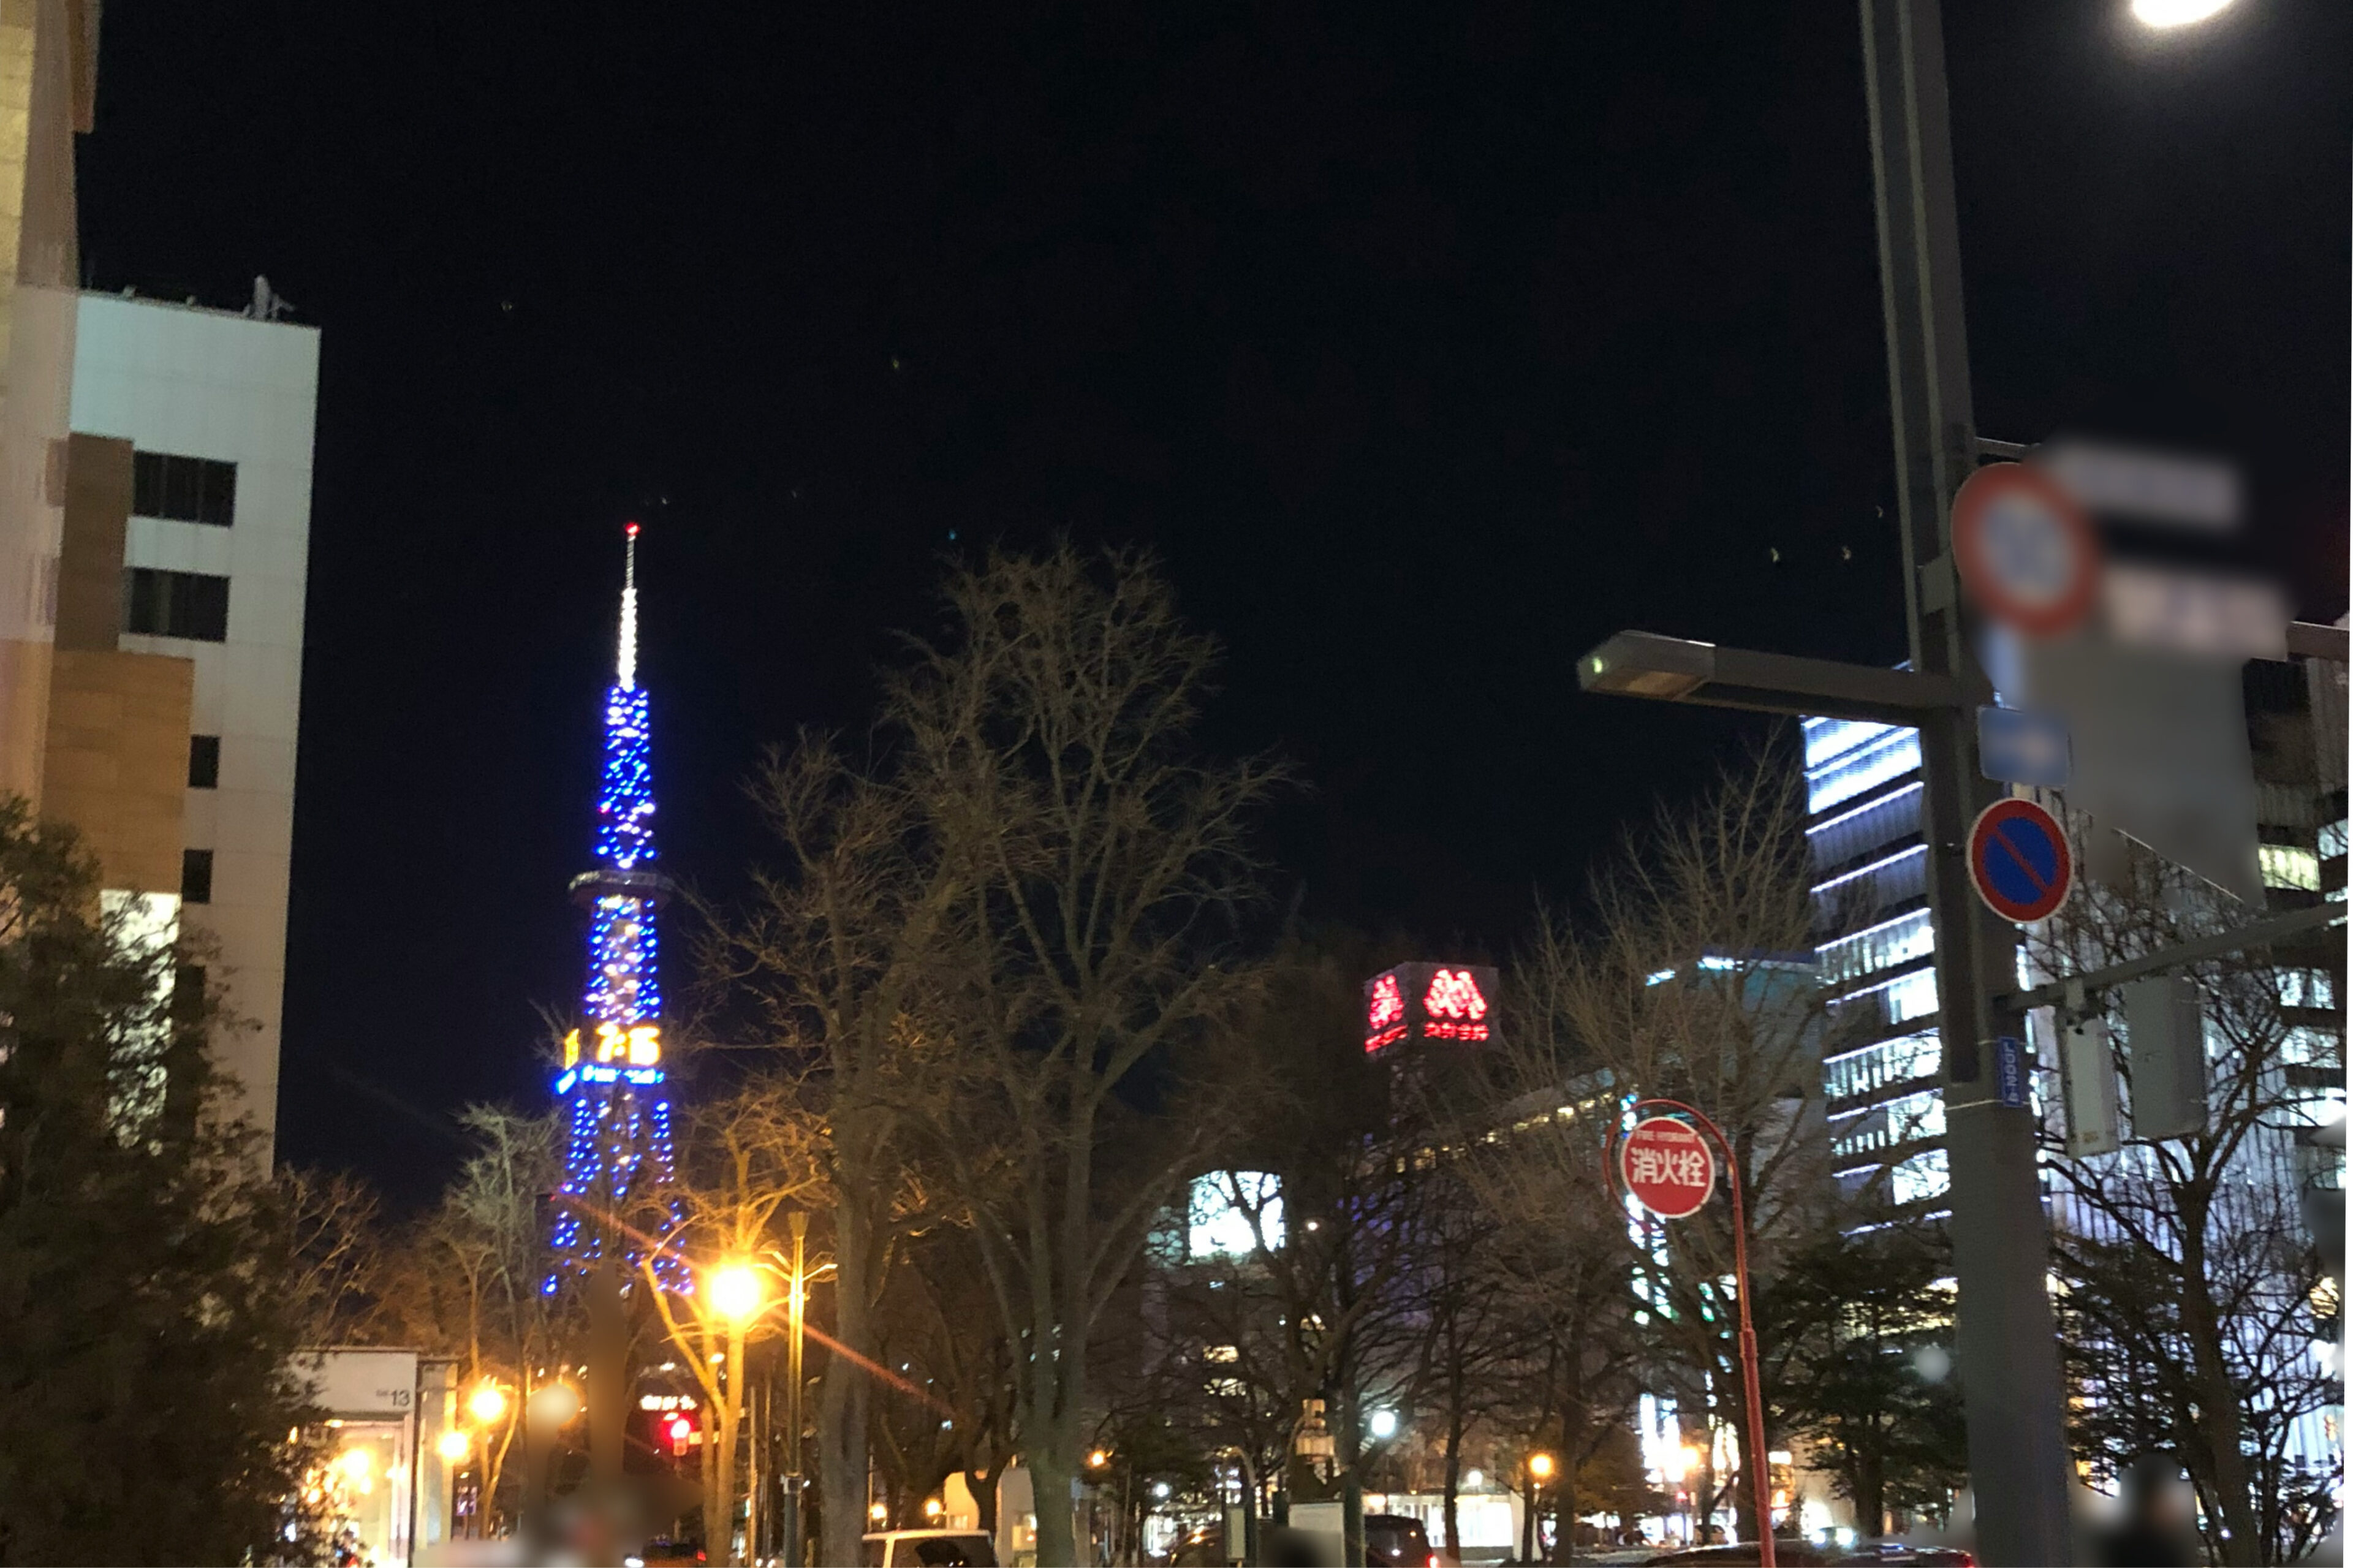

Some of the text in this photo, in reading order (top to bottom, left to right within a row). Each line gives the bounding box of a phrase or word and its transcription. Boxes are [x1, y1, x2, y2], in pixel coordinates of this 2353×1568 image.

[1631, 1147, 1706, 1187] 消火栓
[391, 1389, 411, 1407] 13
